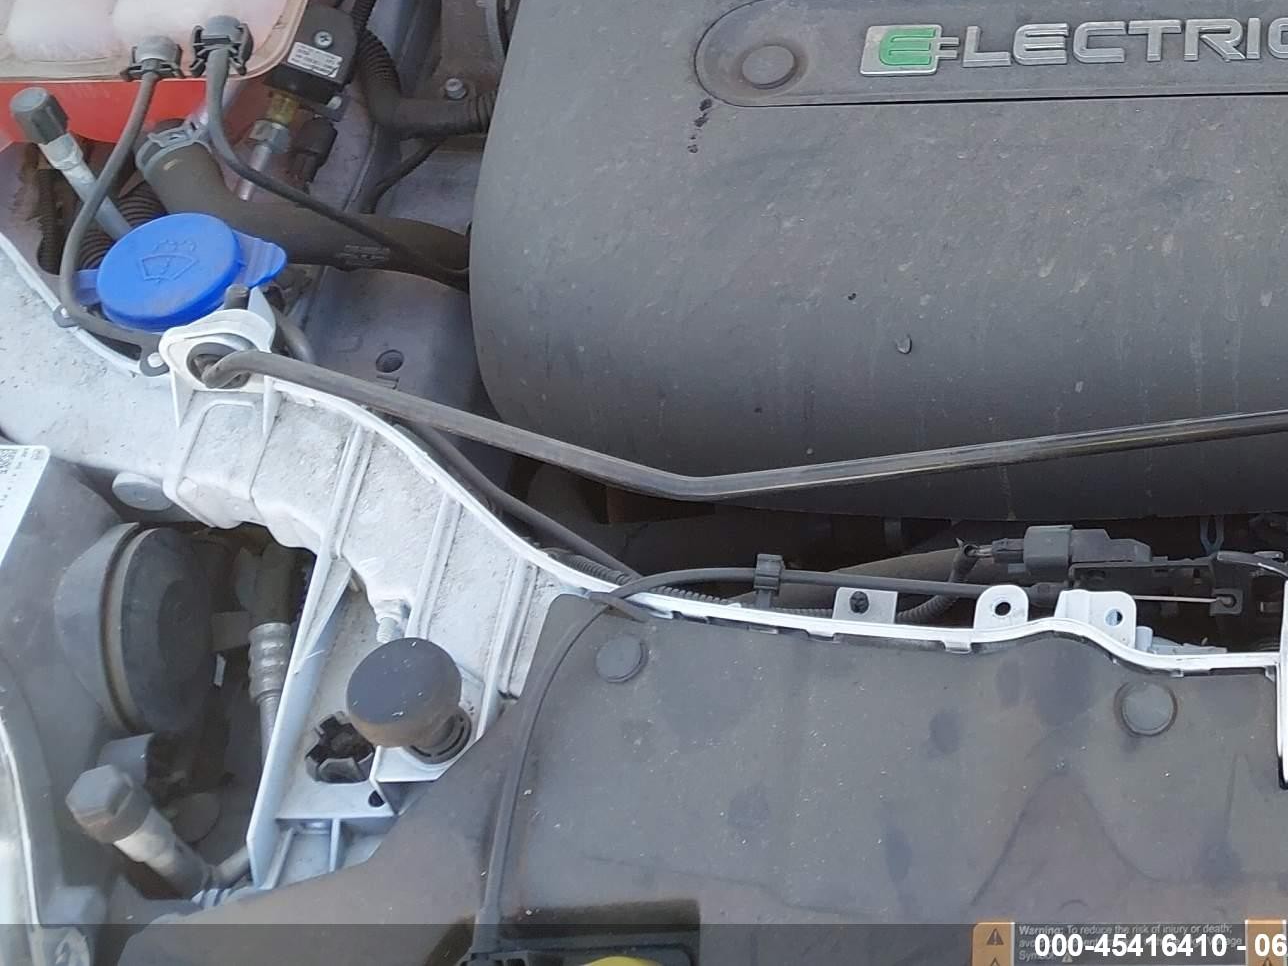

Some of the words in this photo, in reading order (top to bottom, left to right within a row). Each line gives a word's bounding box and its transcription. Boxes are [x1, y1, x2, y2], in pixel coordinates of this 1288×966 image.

[1018, 925, 1064, 936] Warning:
[1067, 925, 1078, 934] To
[1080, 925, 1112, 934] reduce
[1114, 925, 1129, 934] the
[1131, 924, 1149, 933] risk
[1151, 924, 1161, 933] of
